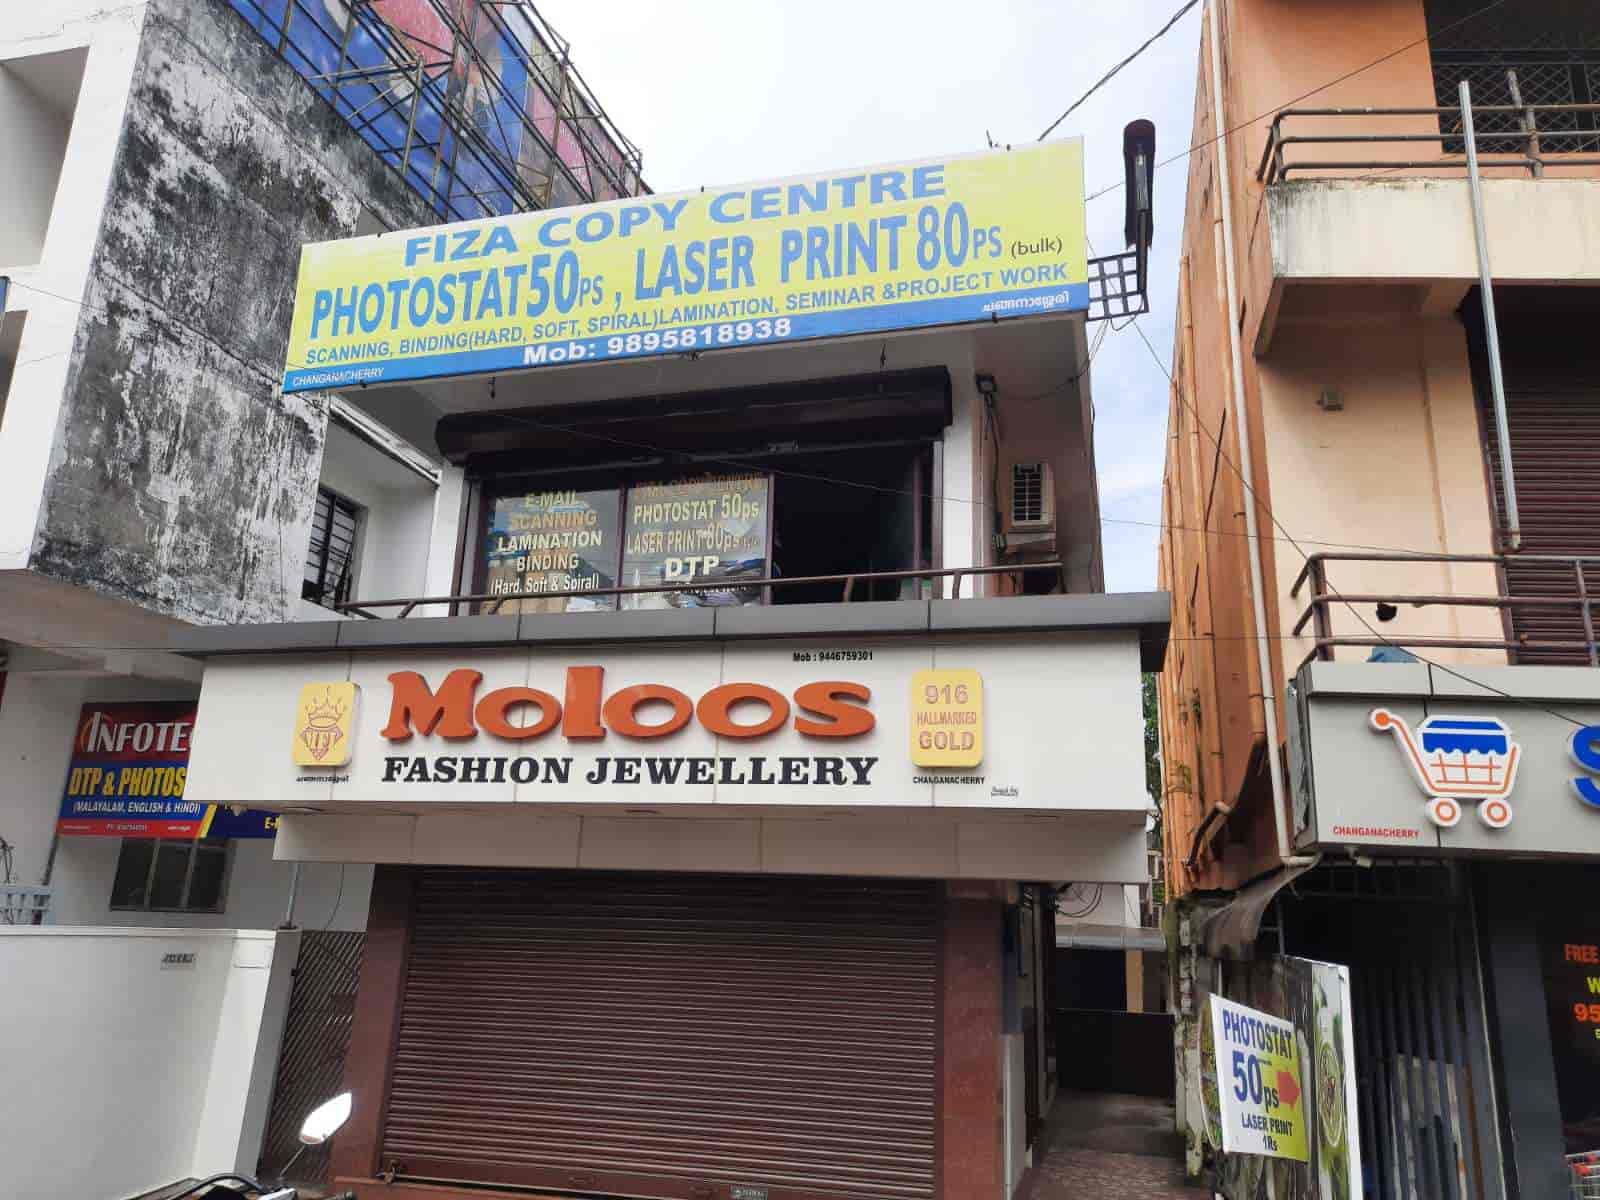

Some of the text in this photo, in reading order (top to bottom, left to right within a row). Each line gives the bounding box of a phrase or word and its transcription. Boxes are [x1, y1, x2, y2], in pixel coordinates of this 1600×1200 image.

[405, 164, 945, 266] FIZA COPY CENTRE
[635, 235, 753, 300] LASER
[781, 215, 908, 284] PRINT
[1011, 236, 1063, 259] (bulk)
[305, 340, 392, 365] SCANNING,
[533, 319, 581, 340] SOFT,
[786, 285, 875, 310] SEMINAR
[1000, 262, 1069, 285] WORK
[522, 316, 791, 365] Mob: 9895818938
[292, 368, 385, 386] CHANGANACHERRY
[634, 499, 717, 524] PHOTOSTAT
[498, 530, 601, 552] LAMINATION
[516, 553, 579, 572] BINDING
[664, 555, 720, 582] DTP
[925, 684, 969, 704] 916
[87, 712, 194, 752] INFOTE
[919, 731, 975, 750] GOLD
[68, 767, 102, 796] DTP
[103, 771, 115, 795] &
[381, 756, 878, 786] FASHION JEWELLERY
[128, 801, 163, 813] ENGLISH
[1222, 1009, 1292, 1060] PHOTOSTAT
